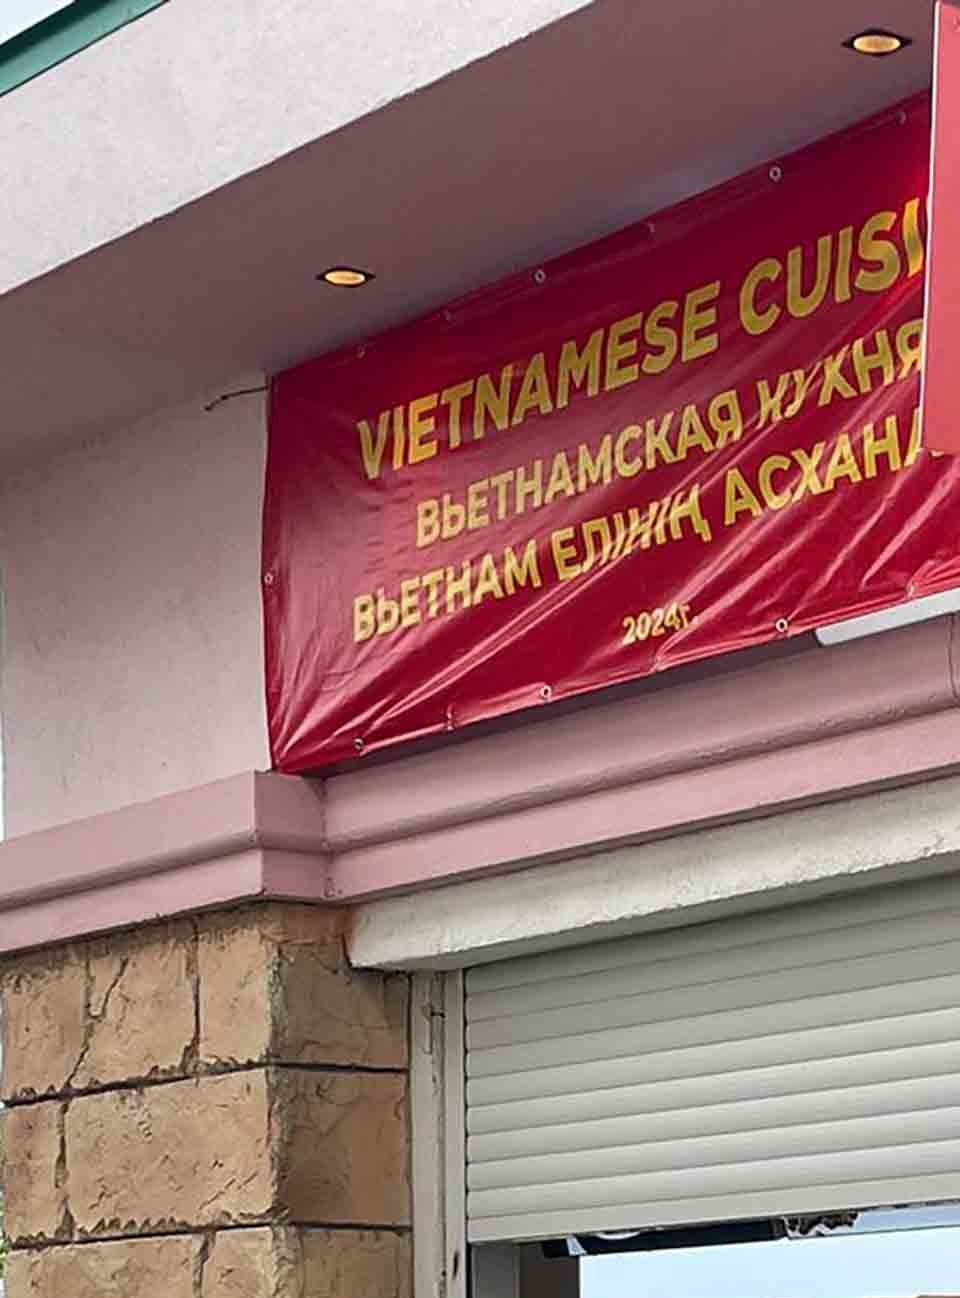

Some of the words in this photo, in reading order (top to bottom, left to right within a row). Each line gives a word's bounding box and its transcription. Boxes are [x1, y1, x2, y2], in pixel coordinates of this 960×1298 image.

[356, 280, 721, 480] VIETNAMESE
[739, 197, 930, 336] CUISI
[416, 389, 743, 548] ВЬЕТНАМСКАЯ
[756, 318, 924, 430] КУХНЯ
[352, 537, 542, 643] ВЬЕТНАМ
